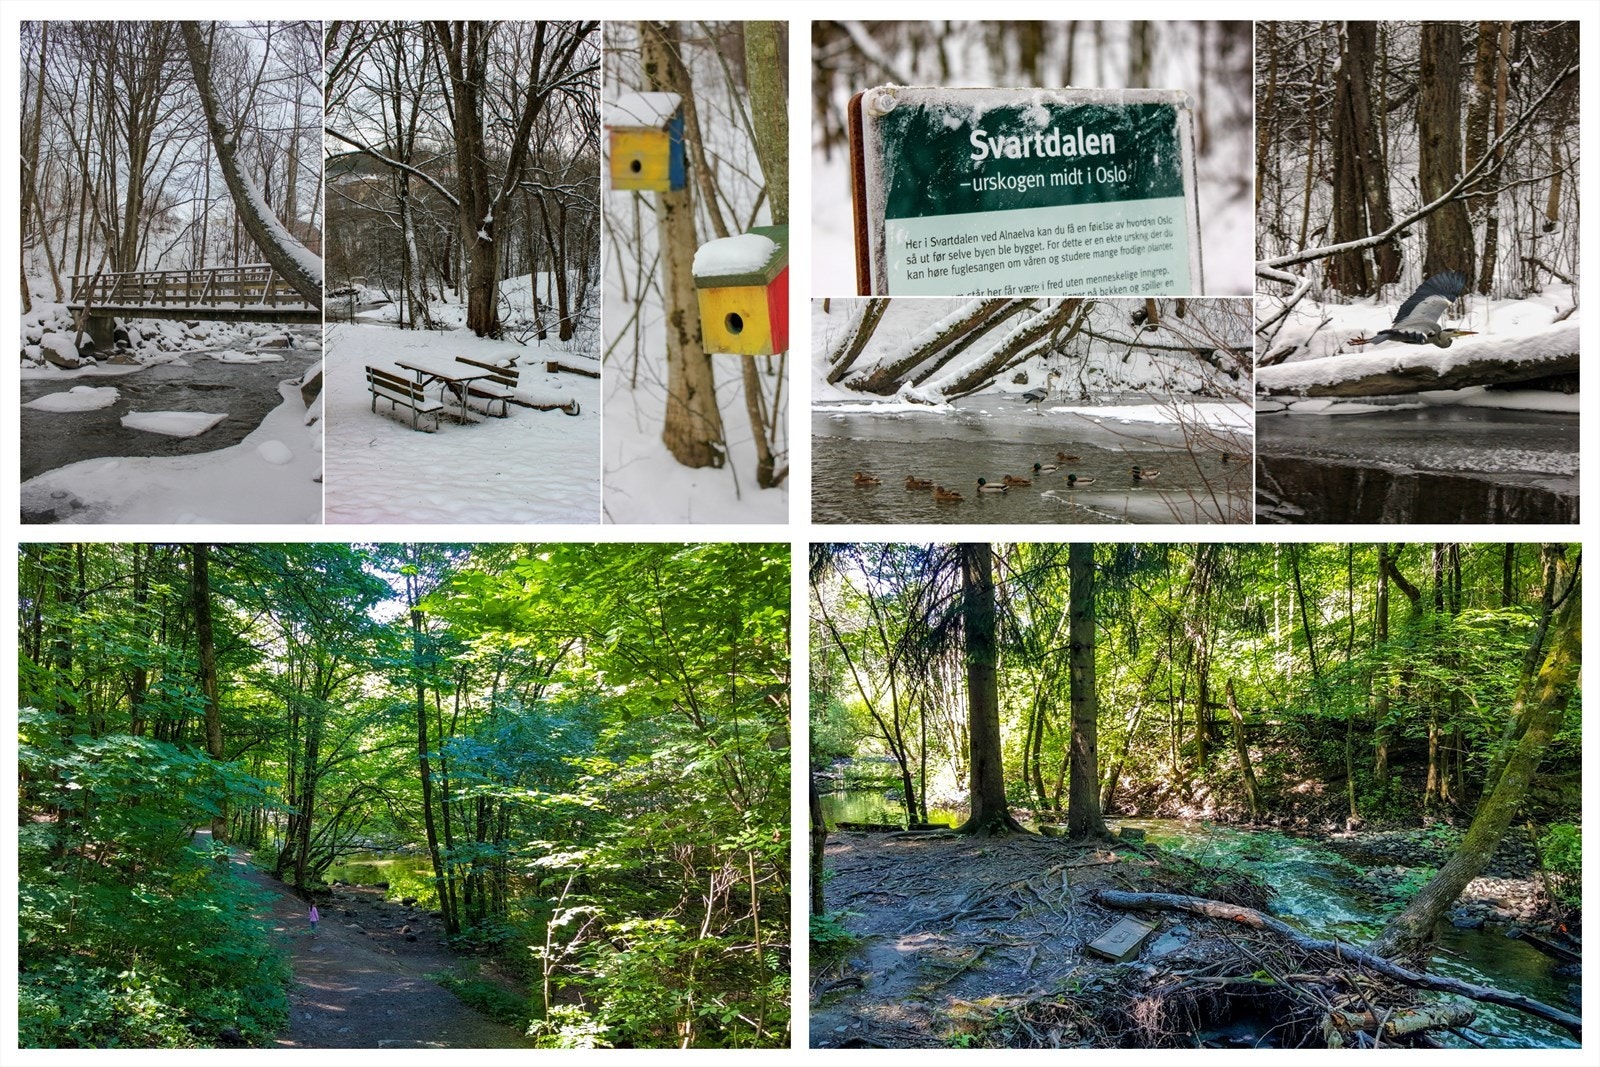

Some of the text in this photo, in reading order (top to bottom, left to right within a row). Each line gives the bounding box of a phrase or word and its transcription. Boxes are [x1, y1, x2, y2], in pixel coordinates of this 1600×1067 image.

[970, 126, 1115, 160] Svartdalen
[1051, 168, 1083, 187] midt
[1088, 167, 1091, 183] i
[1096, 166, 1127, 183] Oslo
[906, 239, 921, 249] Her
[925, 238, 927, 247] i
[931, 234, 978, 247] Svartdalen
[981, 231, 997, 241] ved
[999, 229, 1034, 240] Alnaelva
[1037, 227, 1051, 236] kan
[1055, 225, 1064, 234] du
[1068, 224, 1074, 234] få
[1116, 221, 1124, 229] av
[1126, 217, 1155, 228] hvordan
[907, 253, 917, 265] så
[921, 254, 929, 263] ut
[933, 252, 946, 262] før
[949, 250, 971, 260] selve
[975, 248, 995, 259] byen
[999, 245, 1011, 255] ble
[1014, 243, 1044, 254] bygget.
[1048, 240, 1059, 249] For
[1062, 239, 1082, 248] dette
[1095, 237, 1104, 245] en
[1106, 234, 1122, 243] ekte
[1151, 230, 1162, 239] der
[1164, 229, 1173, 237] du
[907, 270, 924, 280] kan
[928, 268, 948, 278] høre
[952, 264, 1004, 276] fuglesangen
[1008, 260, 1021, 268] om
[1024, 256, 1046, 266] våren
[1049, 256, 1059, 265] og
[1062, 251, 1090, 262] studere
[1093, 248, 1118, 258] mange
[1121, 245, 1145, 255] frodige
[987, 288, 1001, 296] her
[1005, 285, 1016, 295] får
[1042, 282, 1044, 290] i
[1047, 279, 1063, 289] fred
[1066, 279, 1083, 287] uten
[1086, 271, 1137, 284] menneskelige
[1140, 268, 1169, 278] inngrep.
[1130, 284, 1139, 293] og
[1142, 280, 1162, 291] spiller
